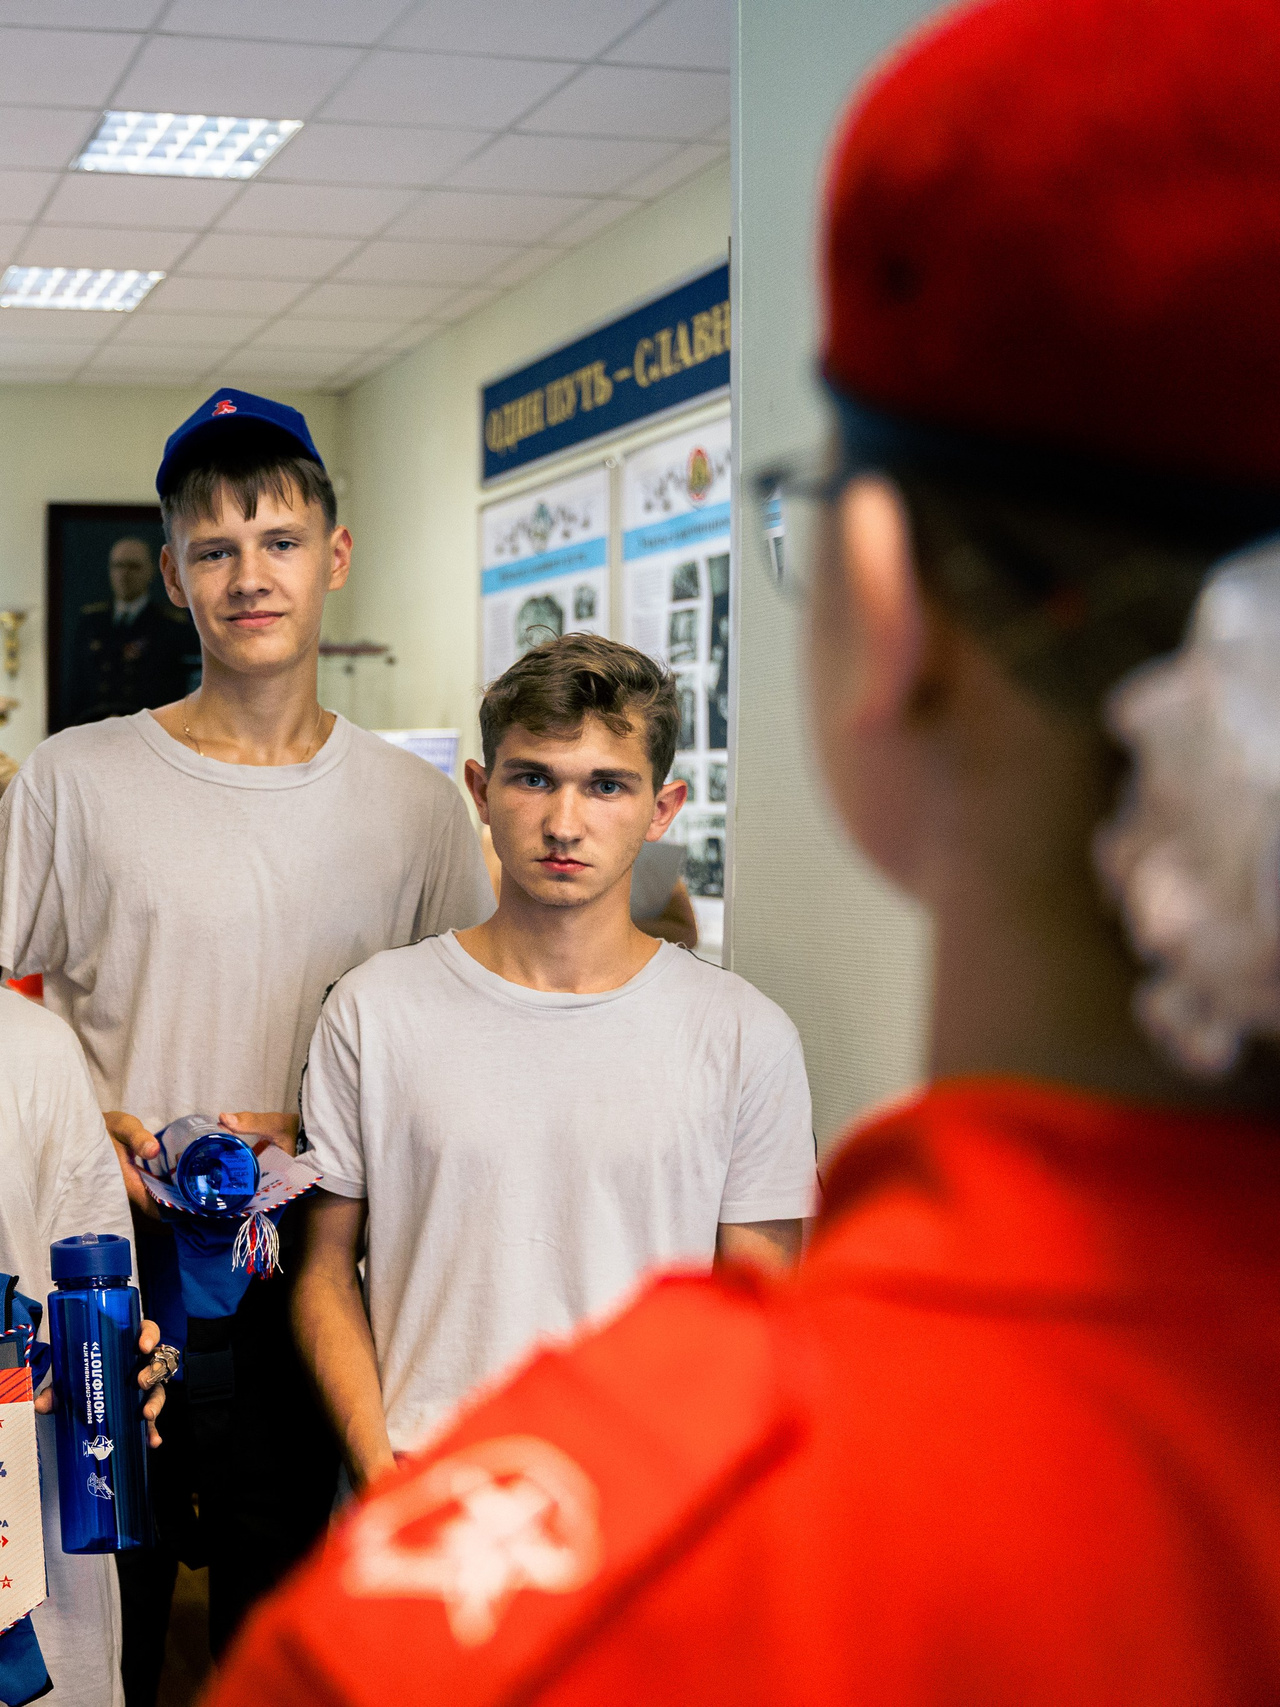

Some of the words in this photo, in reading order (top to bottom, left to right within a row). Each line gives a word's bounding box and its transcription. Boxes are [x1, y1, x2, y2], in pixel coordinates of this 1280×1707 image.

[485, 387, 546, 456] ОДИН
[546, 360, 613, 428] ПУТЬ
[90, 1341, 105, 1424] «ЮНФЛОТ»
